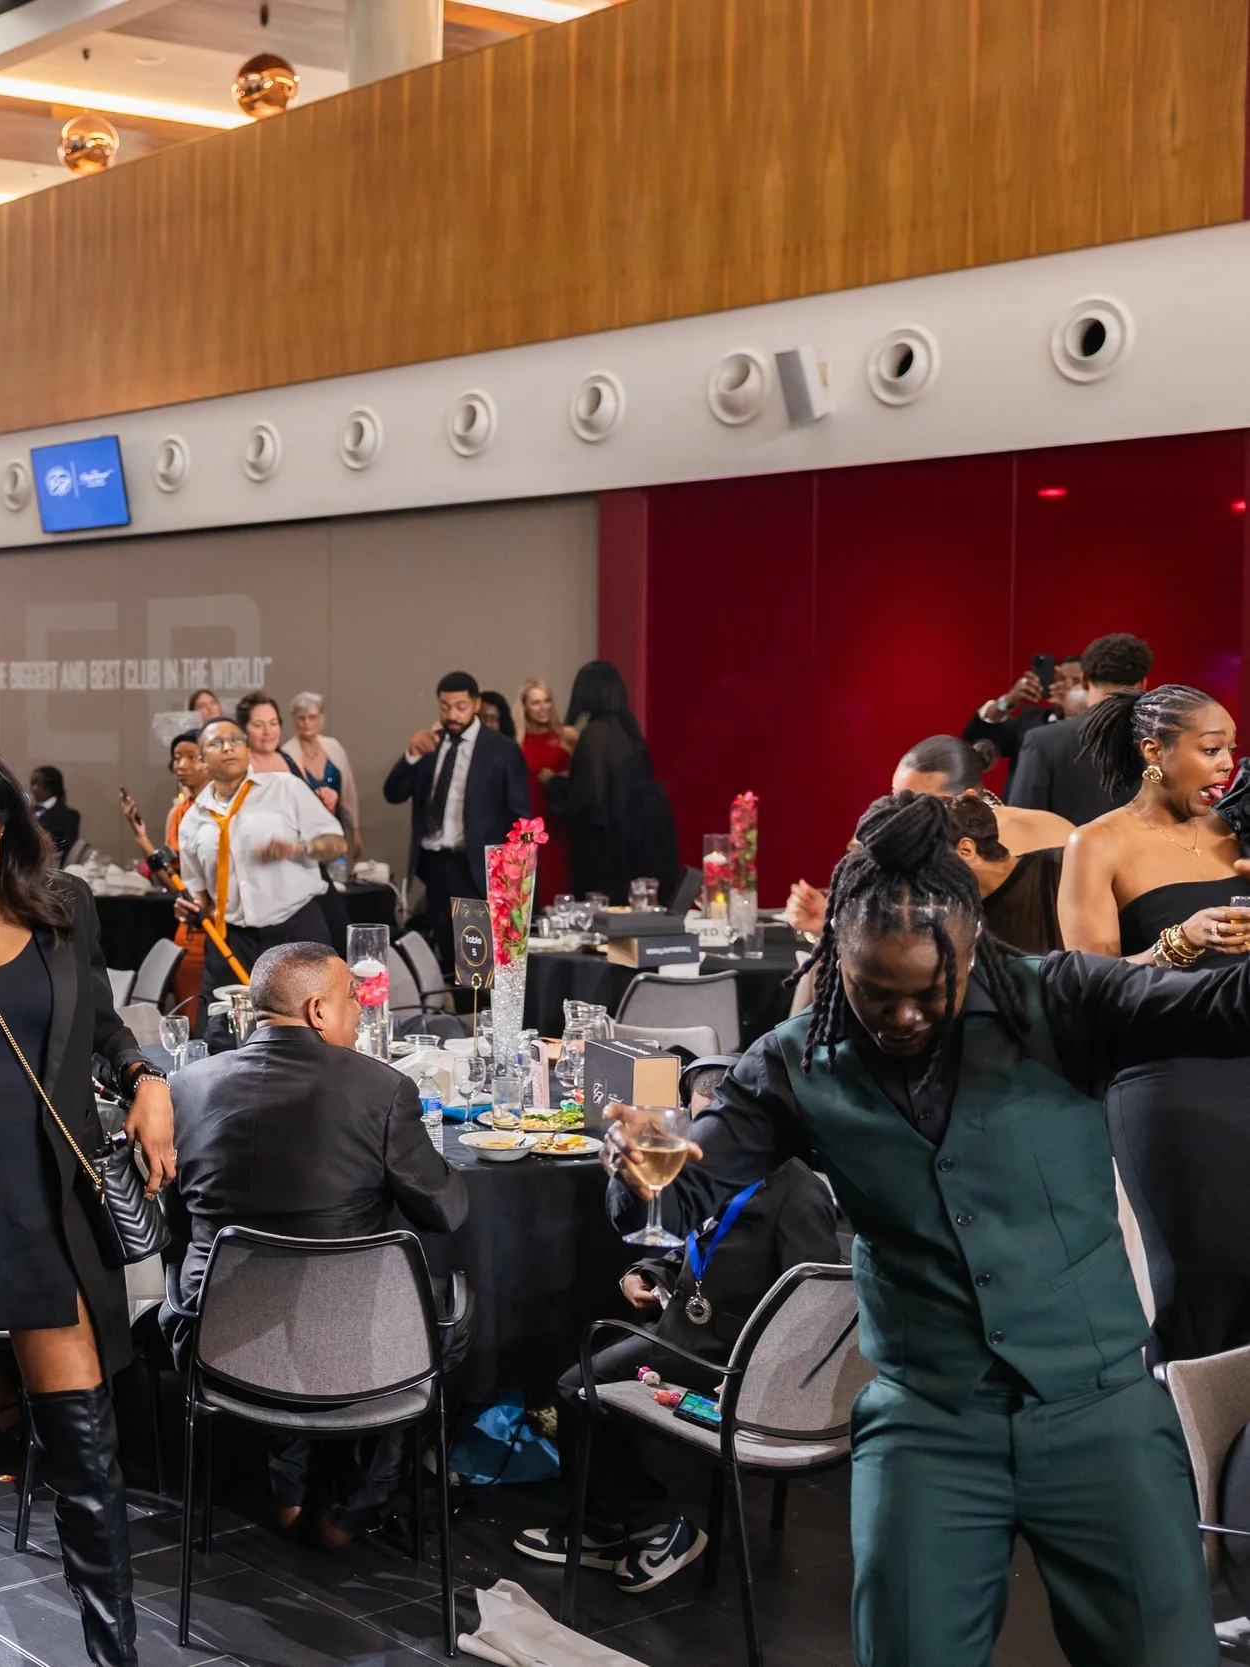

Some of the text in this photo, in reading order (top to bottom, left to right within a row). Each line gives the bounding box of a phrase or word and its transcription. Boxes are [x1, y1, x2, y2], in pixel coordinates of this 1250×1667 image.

[60, 661, 87, 689] AND
[90, 660, 122, 689] BEST
[124, 659, 160, 689] CLUB
[163, 659, 179, 688] IN
[181, 658, 207, 688] THE
[464, 935, 482, 945] Table
[471, 947, 478, 957] 5
